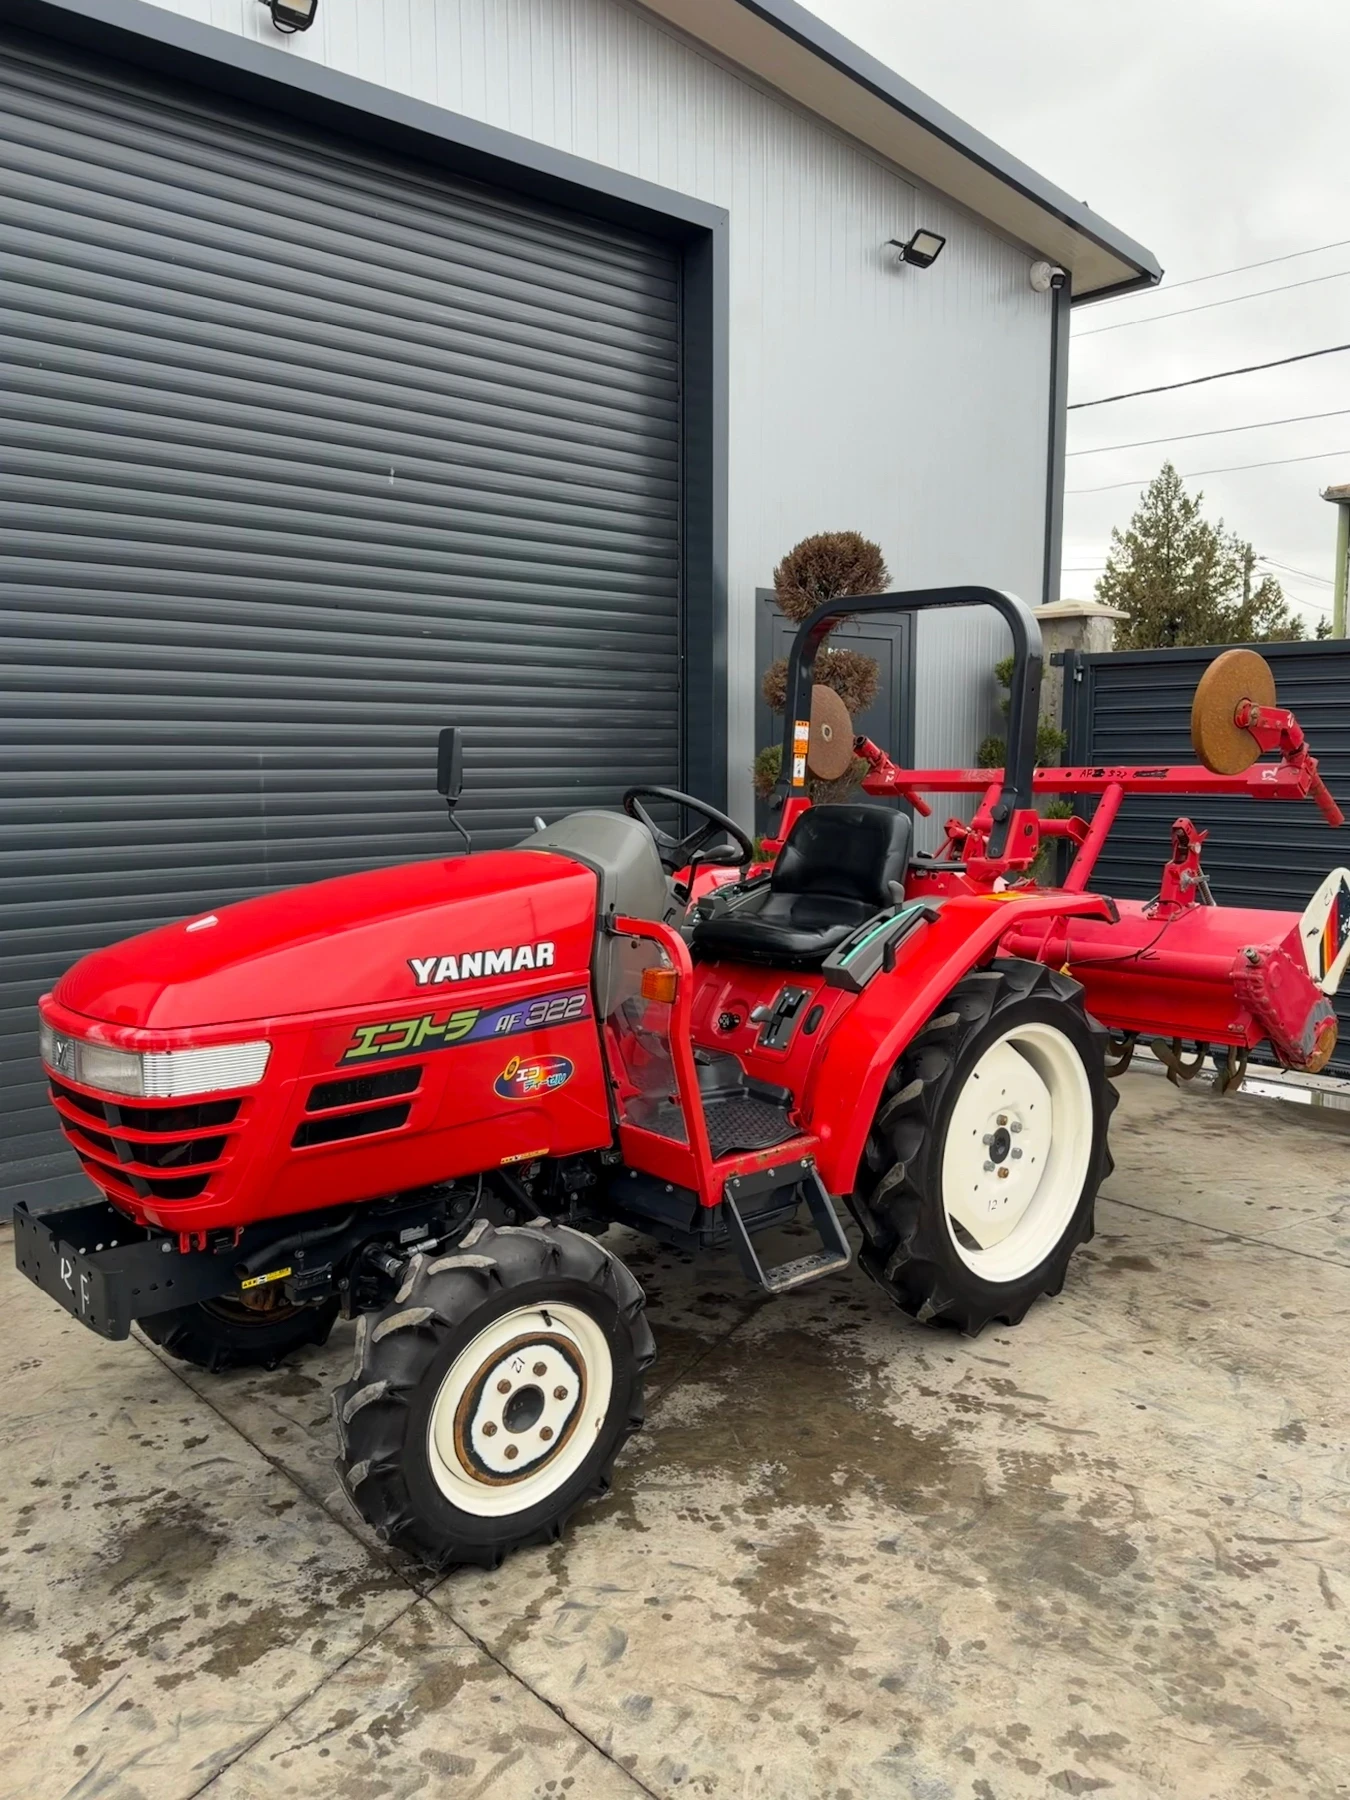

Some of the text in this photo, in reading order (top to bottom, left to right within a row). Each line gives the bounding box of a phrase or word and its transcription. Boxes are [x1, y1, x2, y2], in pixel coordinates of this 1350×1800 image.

[409, 942, 555, 985] YANMAR
[344, 1009, 480, 1059] エコトラ
[494, 994, 587, 1034] AF 322
[516, 1066, 540, 1082] エコ
[988, 1199, 998, 1212] 12
